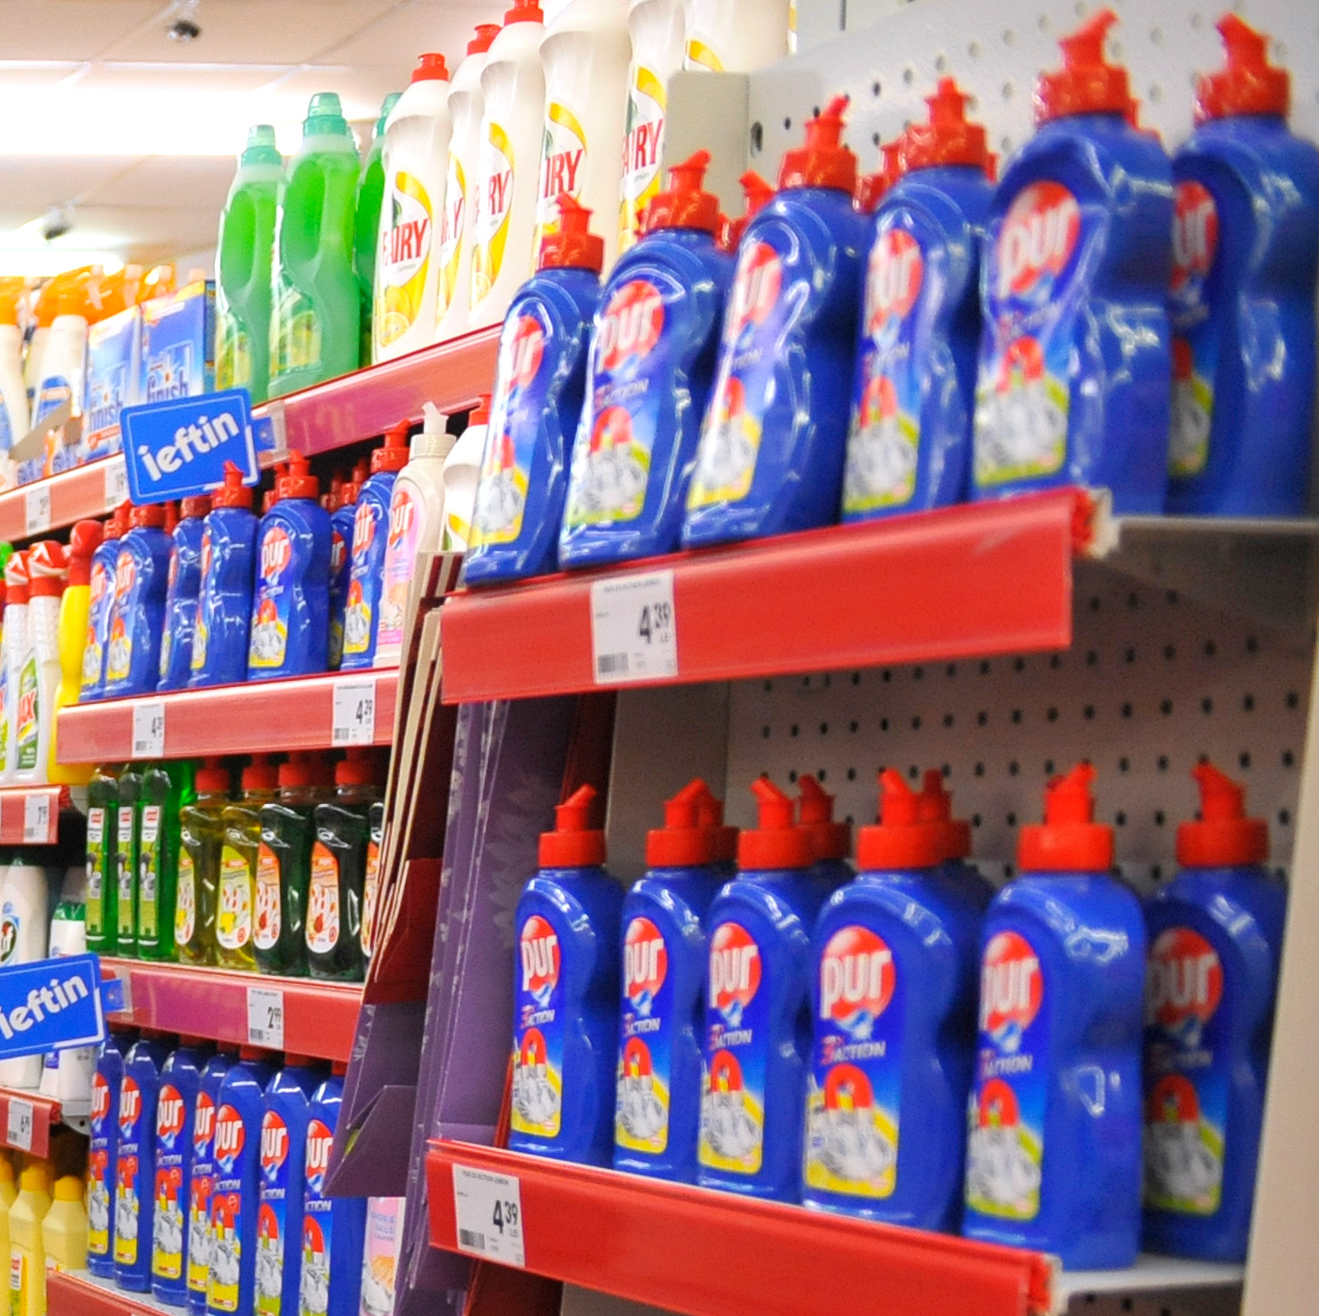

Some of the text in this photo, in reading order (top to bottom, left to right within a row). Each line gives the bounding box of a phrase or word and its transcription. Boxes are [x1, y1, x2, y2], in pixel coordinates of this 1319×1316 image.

[998, 186, 1079, 300] pur
[138, 406, 241, 483] ieftin
[262, 540, 291, 576] pur
[521, 935, 556, 992] pur
[624, 937, 665, 1000] pur
[709, 941, 759, 1011] pur
[819, 949, 893, 1020] pur
[981, 958, 1039, 1032] pur
[215, 1116, 245, 1155] pur
